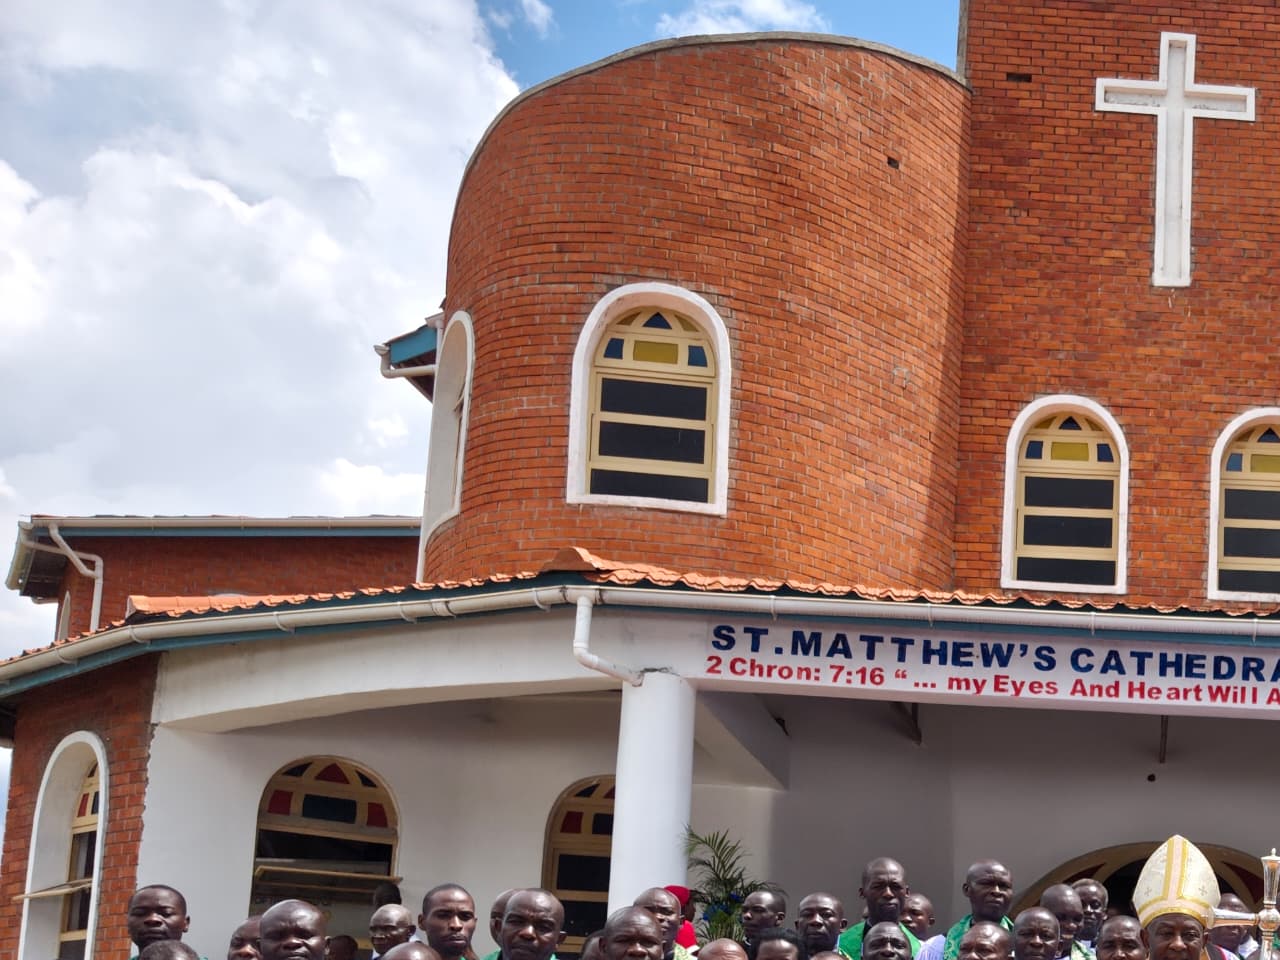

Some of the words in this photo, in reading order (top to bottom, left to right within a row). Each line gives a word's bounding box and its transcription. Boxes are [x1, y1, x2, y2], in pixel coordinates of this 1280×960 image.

[706, 657, 722, 675] 2
[729, 657, 820, 681] Chron:
[829, 664, 885, 687] 7:16
[947, 676, 987, 696] my
[993, 674, 1059, 698] Eyes
[1070, 678, 1121, 699] And
[1127, 681, 1202, 702] Heart
[1207, 685, 1258, 705] Will
